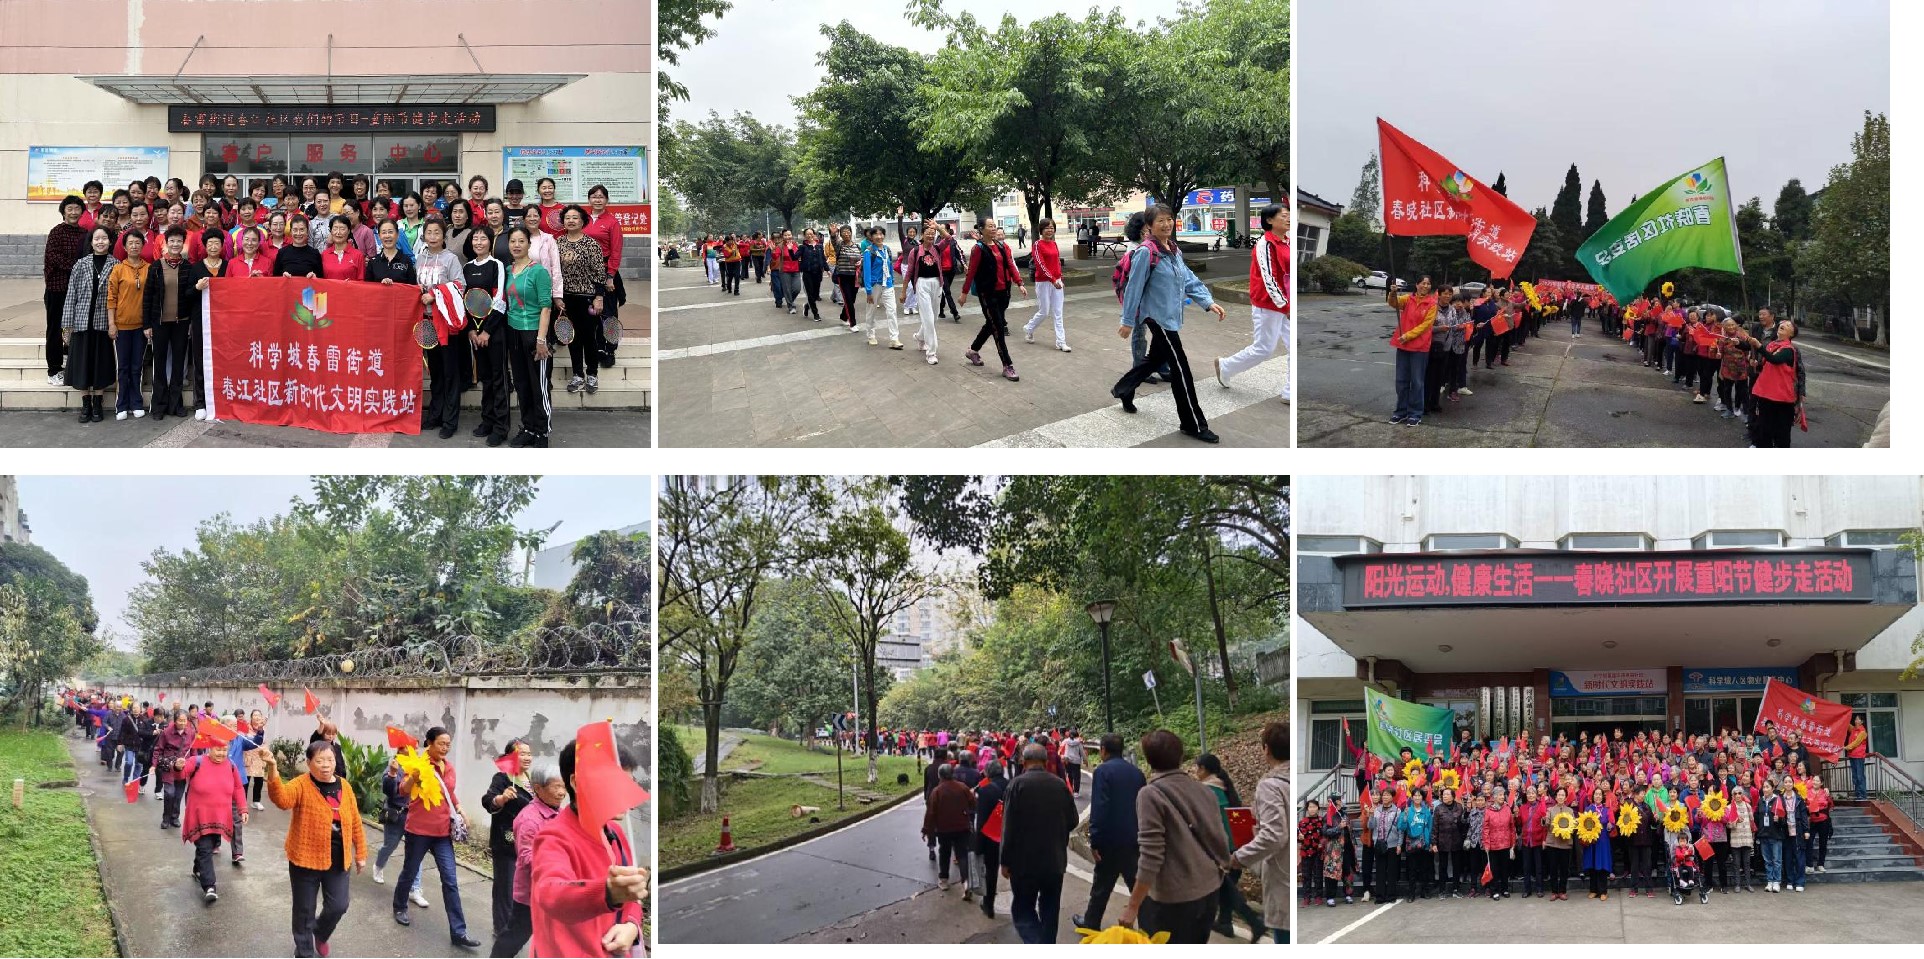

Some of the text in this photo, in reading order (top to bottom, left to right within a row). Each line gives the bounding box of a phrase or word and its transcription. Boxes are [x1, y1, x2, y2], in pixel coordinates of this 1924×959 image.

[249, 340, 385, 377] 科学城春雷街道
[222, 376, 417, 417] 春江社区新时代文明实践站
